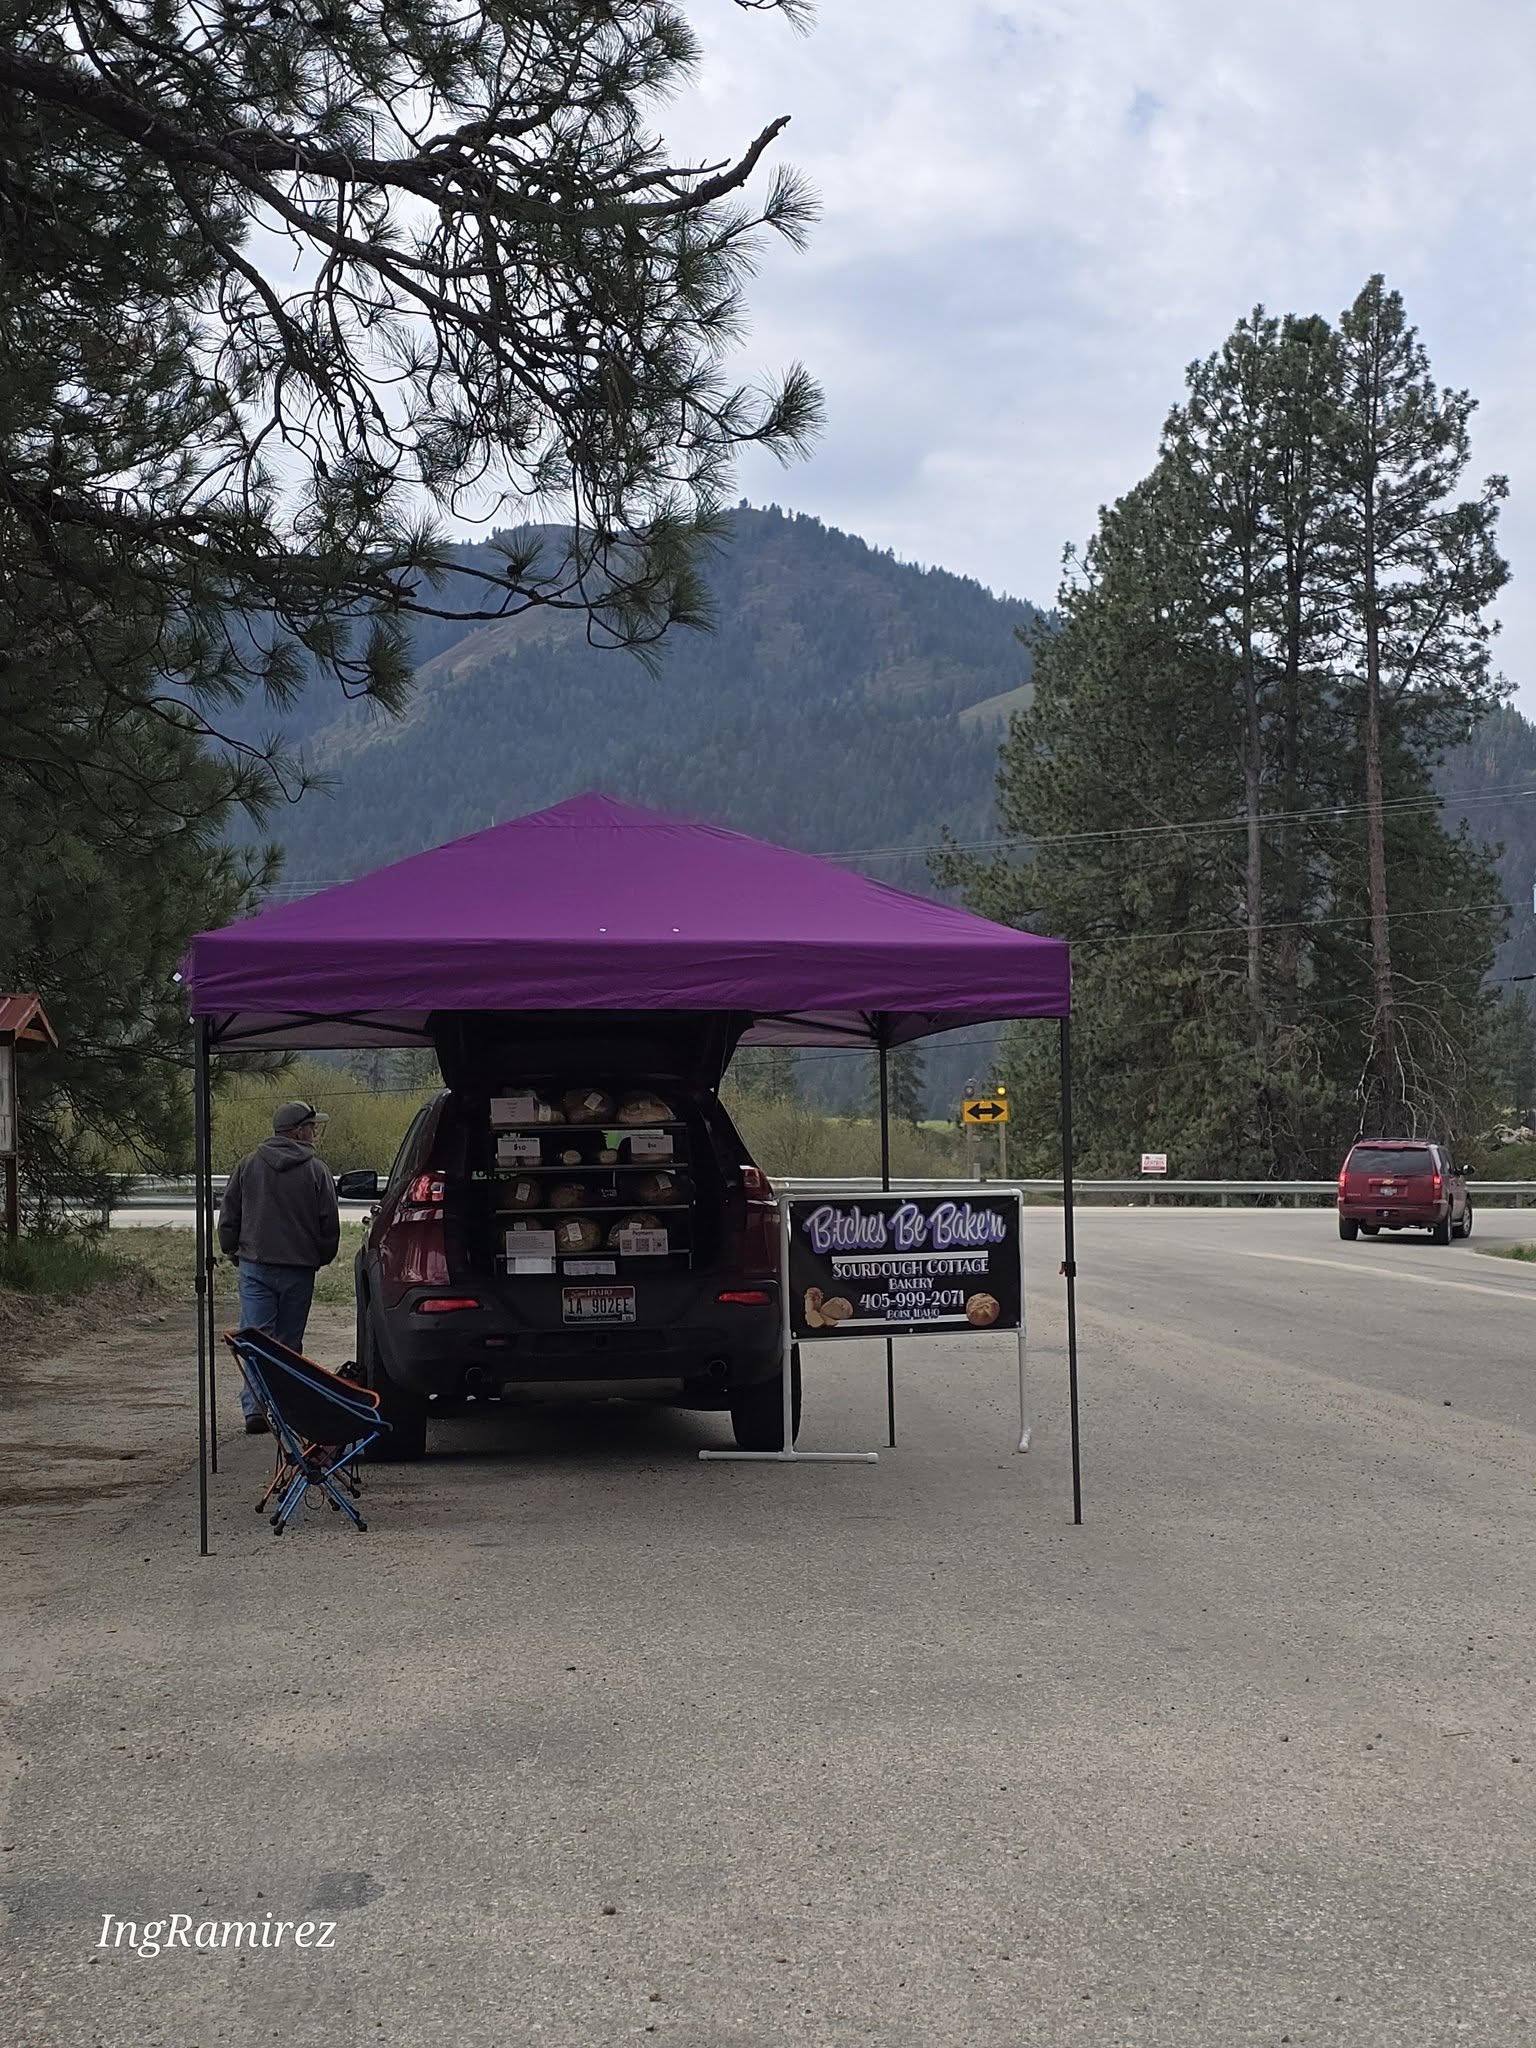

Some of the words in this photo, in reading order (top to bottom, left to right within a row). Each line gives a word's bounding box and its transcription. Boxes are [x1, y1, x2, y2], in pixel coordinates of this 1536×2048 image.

[803, 1205, 889, 1254] Bitches
[887, 1202, 929, 1251] Be
[925, 1201, 1007, 1250] Bake'n
[832, 1260, 923, 1279] SOURDOUGH
[926, 1257, 990, 1275] COTTAGE
[888, 1278, 935, 1291] BAKERY
[568, 1298, 583, 1314] 1A
[859, 1290, 965, 1309] 405-999-2071
